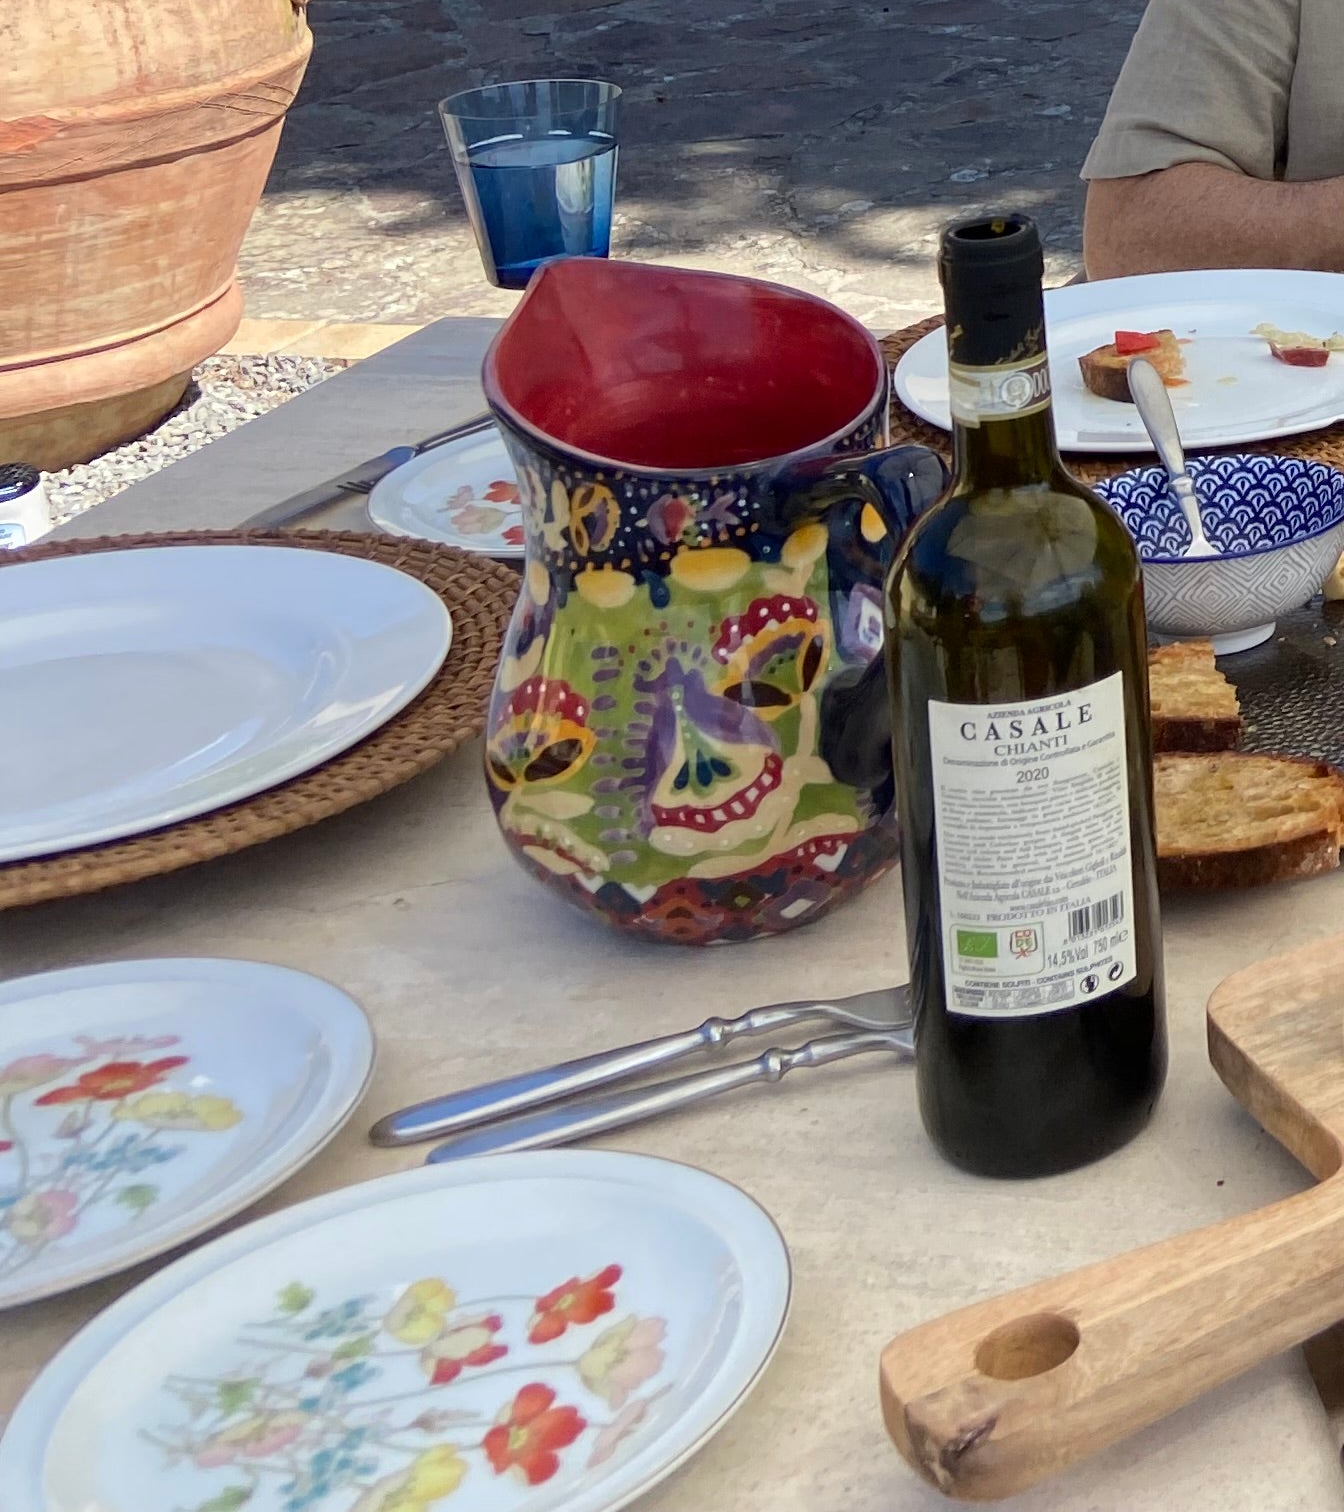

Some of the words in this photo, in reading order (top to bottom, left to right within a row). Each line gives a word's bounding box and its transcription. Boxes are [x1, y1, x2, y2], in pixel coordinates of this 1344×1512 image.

[986, 709, 1026, 719] AZIENDA
[1027, 699, 1072, 715] AGRICOLA
[960, 703, 1092, 741] CASALE
[994, 734, 1068, 757] CHIANTI
[1000, 756, 1009, 766] di
[1010, 754, 1039, 767] Origine
[1016, 766, 1050, 784] 2020
[986, 909, 1044, 922] PRODOTTO
[1059, 896, 1092, 912] ITALIA
